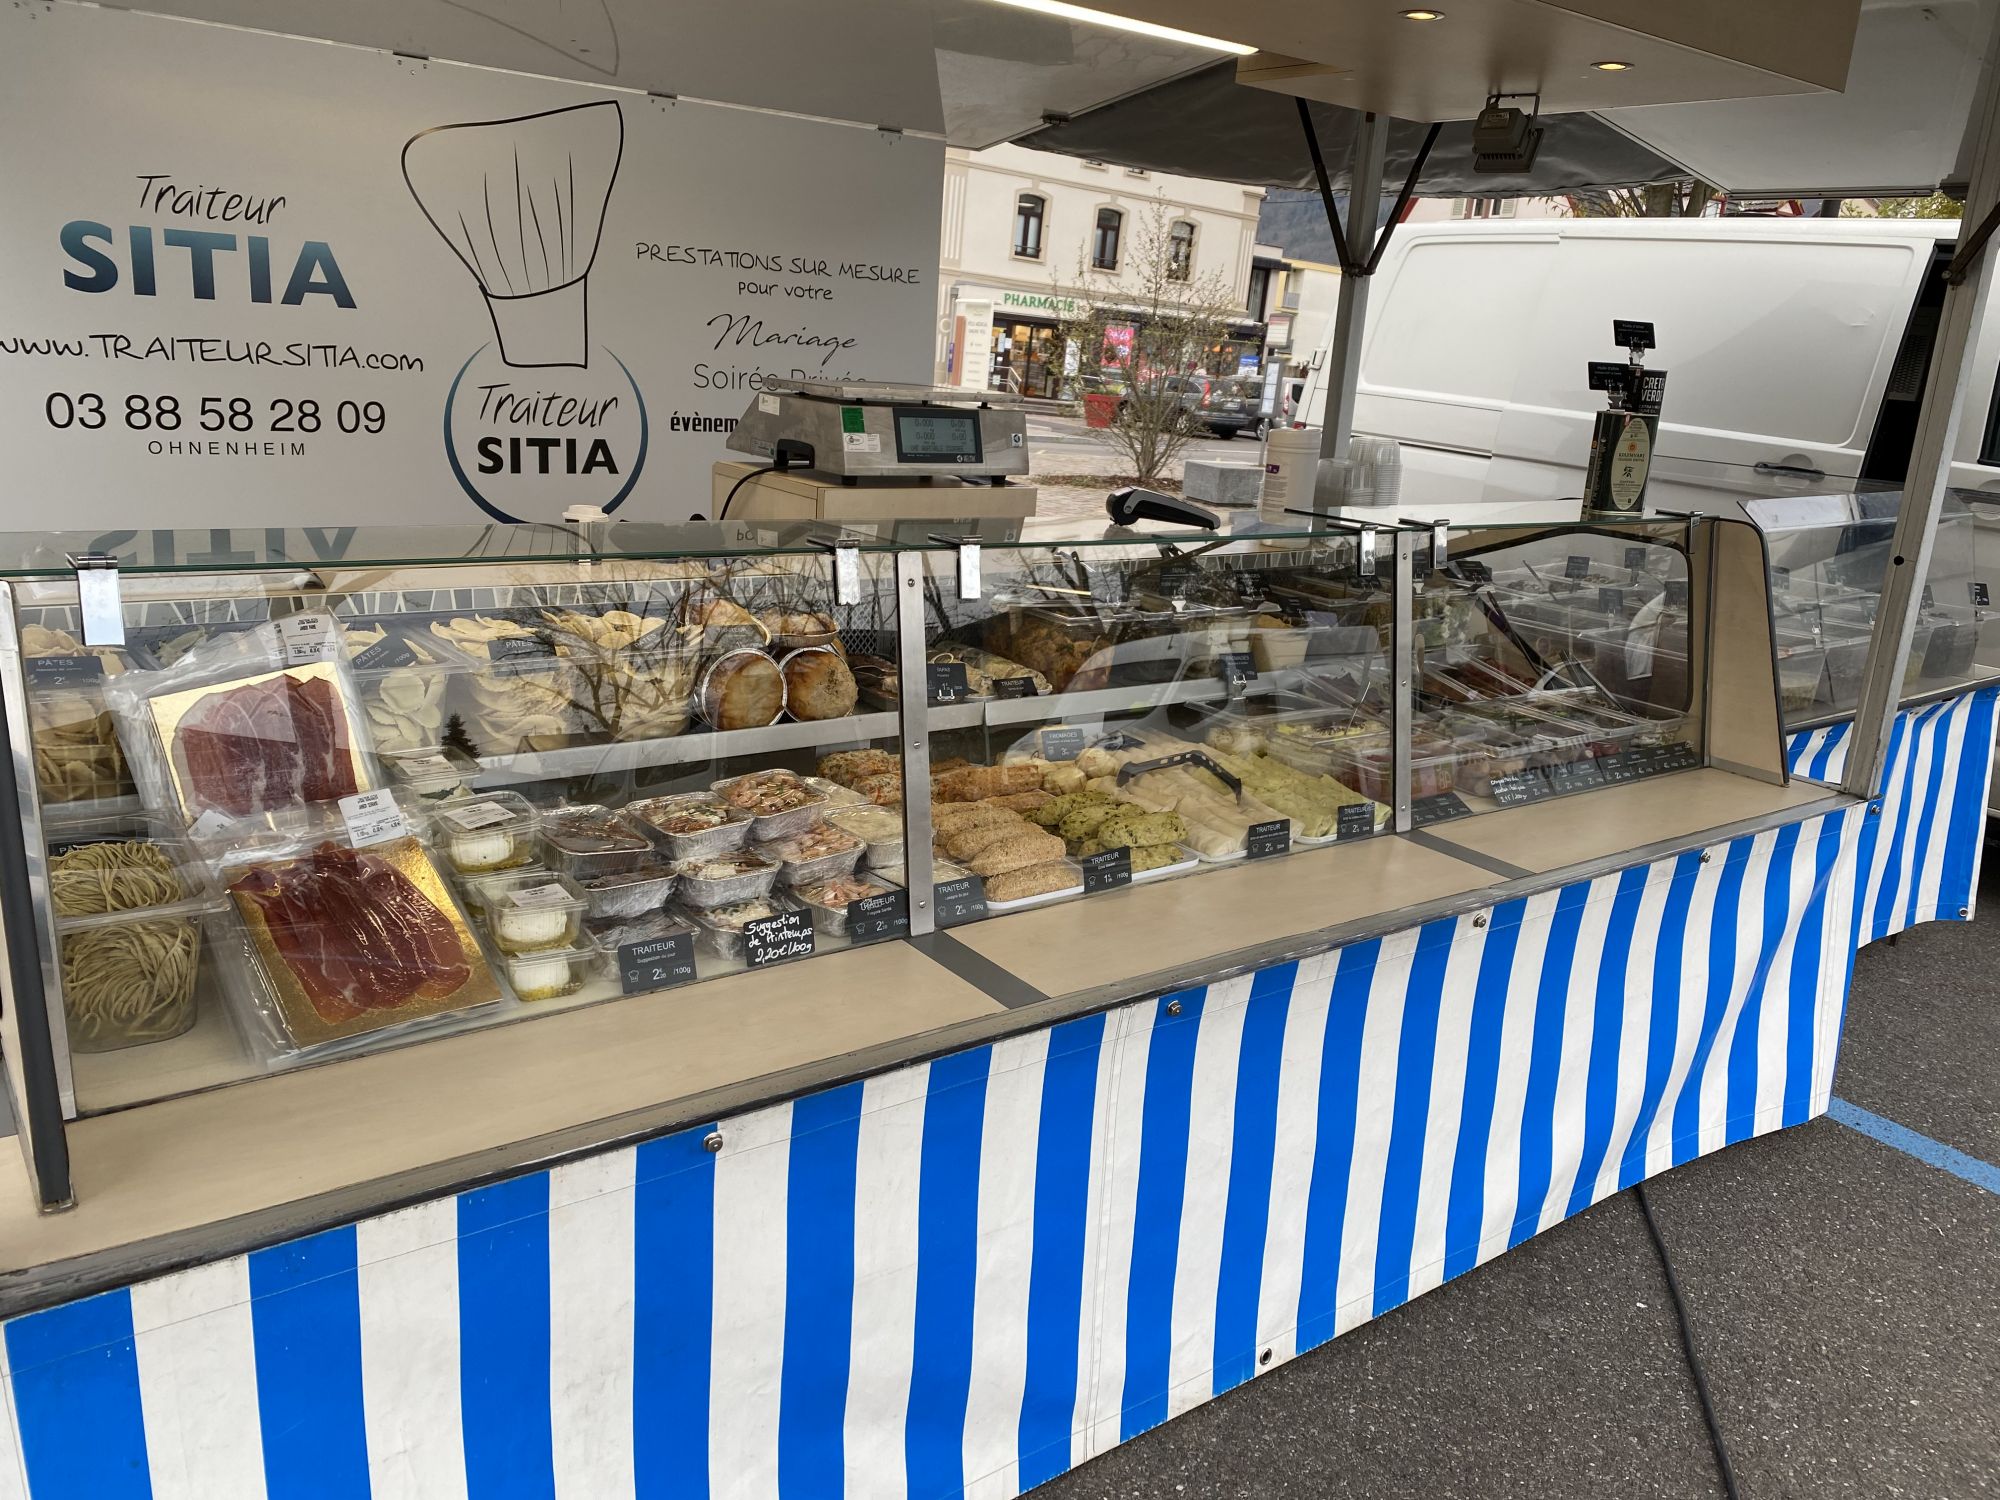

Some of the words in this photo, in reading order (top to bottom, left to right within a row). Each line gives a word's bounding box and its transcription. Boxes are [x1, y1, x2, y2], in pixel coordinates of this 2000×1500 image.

[136, 175, 287, 225] Traiteur
[59, 219, 358, 310] SITIA
[635, 241, 784, 273] PRESTATIONS
[788, 256, 833, 278] SUR
[838, 261, 921, 285] MESURE
[738, 280, 779, 298] pour
[784, 283, 834, 301] votre
[1003, 292, 1075, 313] PHARMACIE
[706, 313, 859, 365] Mariage
[44, 392, 107, 430] 03
[124, 394, 182, 431] 88
[199, 396, 254, 432] 58
[269, 398, 322, 434] 28
[336, 400, 386, 434] 09
[477, 382, 620, 430] Traiteur
[148, 440, 306, 456] OHNENHEIM
[477, 436, 620, 475] SITIA
[1256, 824, 1281, 834] TRAITEUR
[1091, 852, 1120, 864] TRAITEUR
[938, 882, 970, 894] TRAITEUR
[859, 896, 896, 911] TRAITEUR
[970, 904, 984, 912] /100g
[744, 914, 800, 936] Suggestion
[632, 940, 677, 956] TRAITEUR
[748, 934, 762, 948] de
[673, 966, 692, 976] /100g
